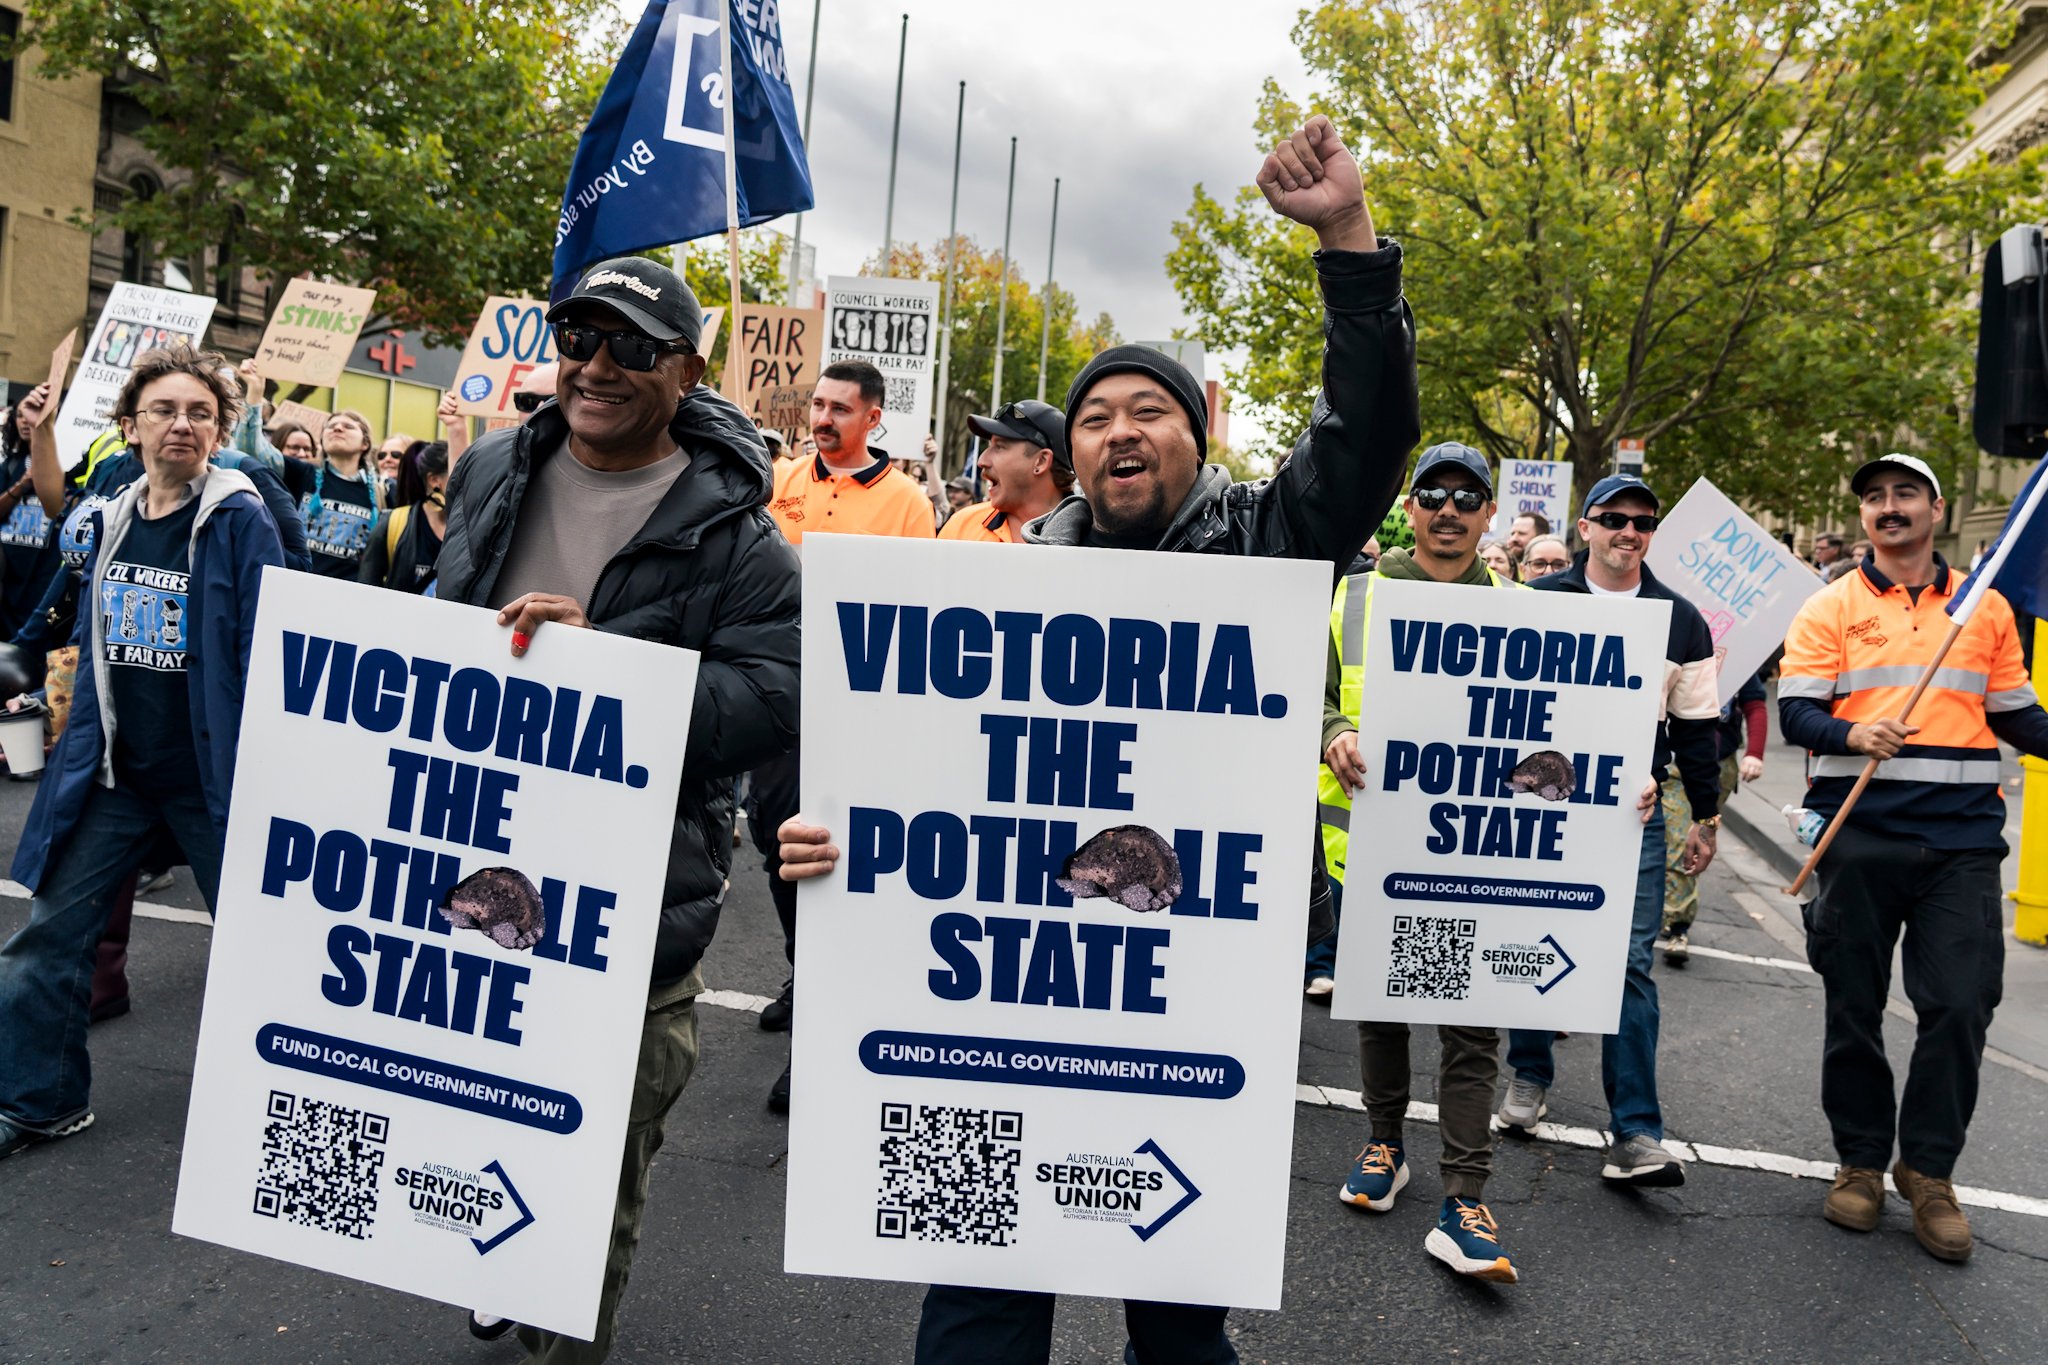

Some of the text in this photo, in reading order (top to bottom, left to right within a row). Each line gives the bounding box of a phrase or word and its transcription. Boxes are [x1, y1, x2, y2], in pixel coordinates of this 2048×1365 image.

[585, 269, 662, 301] Timberland
[112, 303, 200, 329] COUNCIL WORKERS
[834, 293, 930, 311] COUNCIL WORKERS
[277, 304, 363, 335] STINKS
[742, 316, 805, 356] FAIR
[748, 359, 804, 392] PAY
[878, 356, 902, 369] FAIR
[906, 358, 925, 370] PAY
[769, 408, 806, 427] FAIR
[1509, 480, 1556, 498] SHELVE
[1518, 500, 1548, 516] OUR
[1711, 517, 1787, 584] DON'T
[1678, 542, 1766, 619] SHELVE
[124, 646, 154, 666] FAIR
[156, 650, 186, 668] PAY
[836, 601, 1288, 719] VICTORIA.
[1390, 619, 1643, 690] VICTORIA.
[282, 630, 649, 789] VICTORIA.
[1467, 685, 1557, 742] THE
[980, 714, 1137, 811] THE
[1383, 740, 1624, 806] POTHLE
[388, 748, 520, 854] THE
[1426, 802, 1568, 861] STATE
[847, 806, 1263, 921] POTHLE
[261, 816, 617, 972] POTHLE
[1394, 880, 1594, 903] FUND LOCAL GOVERNMENT NOW!
[1481, 950, 1555, 965] SERVICES
[1500, 943, 1539, 951] AUSTRALIAN
[928, 912, 1171, 1015] STATE
[1492, 963, 1542, 977] UNION
[321, 924, 531, 1046] STATE
[272, 1035, 565, 1120] FUND LOCAL GOVERNMENT NOW!
[878, 1043, 1225, 1085] FUND LOCAL GOVERNMENT NOW!
[422, 1162, 480, 1184] AUSTRALIAN
[1066, 1153, 1134, 1167] AUSTRALIAN
[394, 1167, 504, 1210] SERVICES
[1036, 1163, 1163, 1191] SERVICES
[409, 1191, 484, 1226] UNION
[1055, 1186, 1142, 1211] UNION
[1062, 1207, 1093, 1215] VICTORIAN
[1099, 1210, 1133, 1218] TASMANIAN
[414, 1212, 441, 1222] VICTORIAN
[446, 1219, 474, 1231] TASMANIAN
[414, 1218, 445, 1229] AUTHORITIES
[450, 1226, 472, 1236] SERVICES
[1063, 1213, 1099, 1221] AUTHORITIES
[1104, 1216, 1131, 1224] SERVICES
